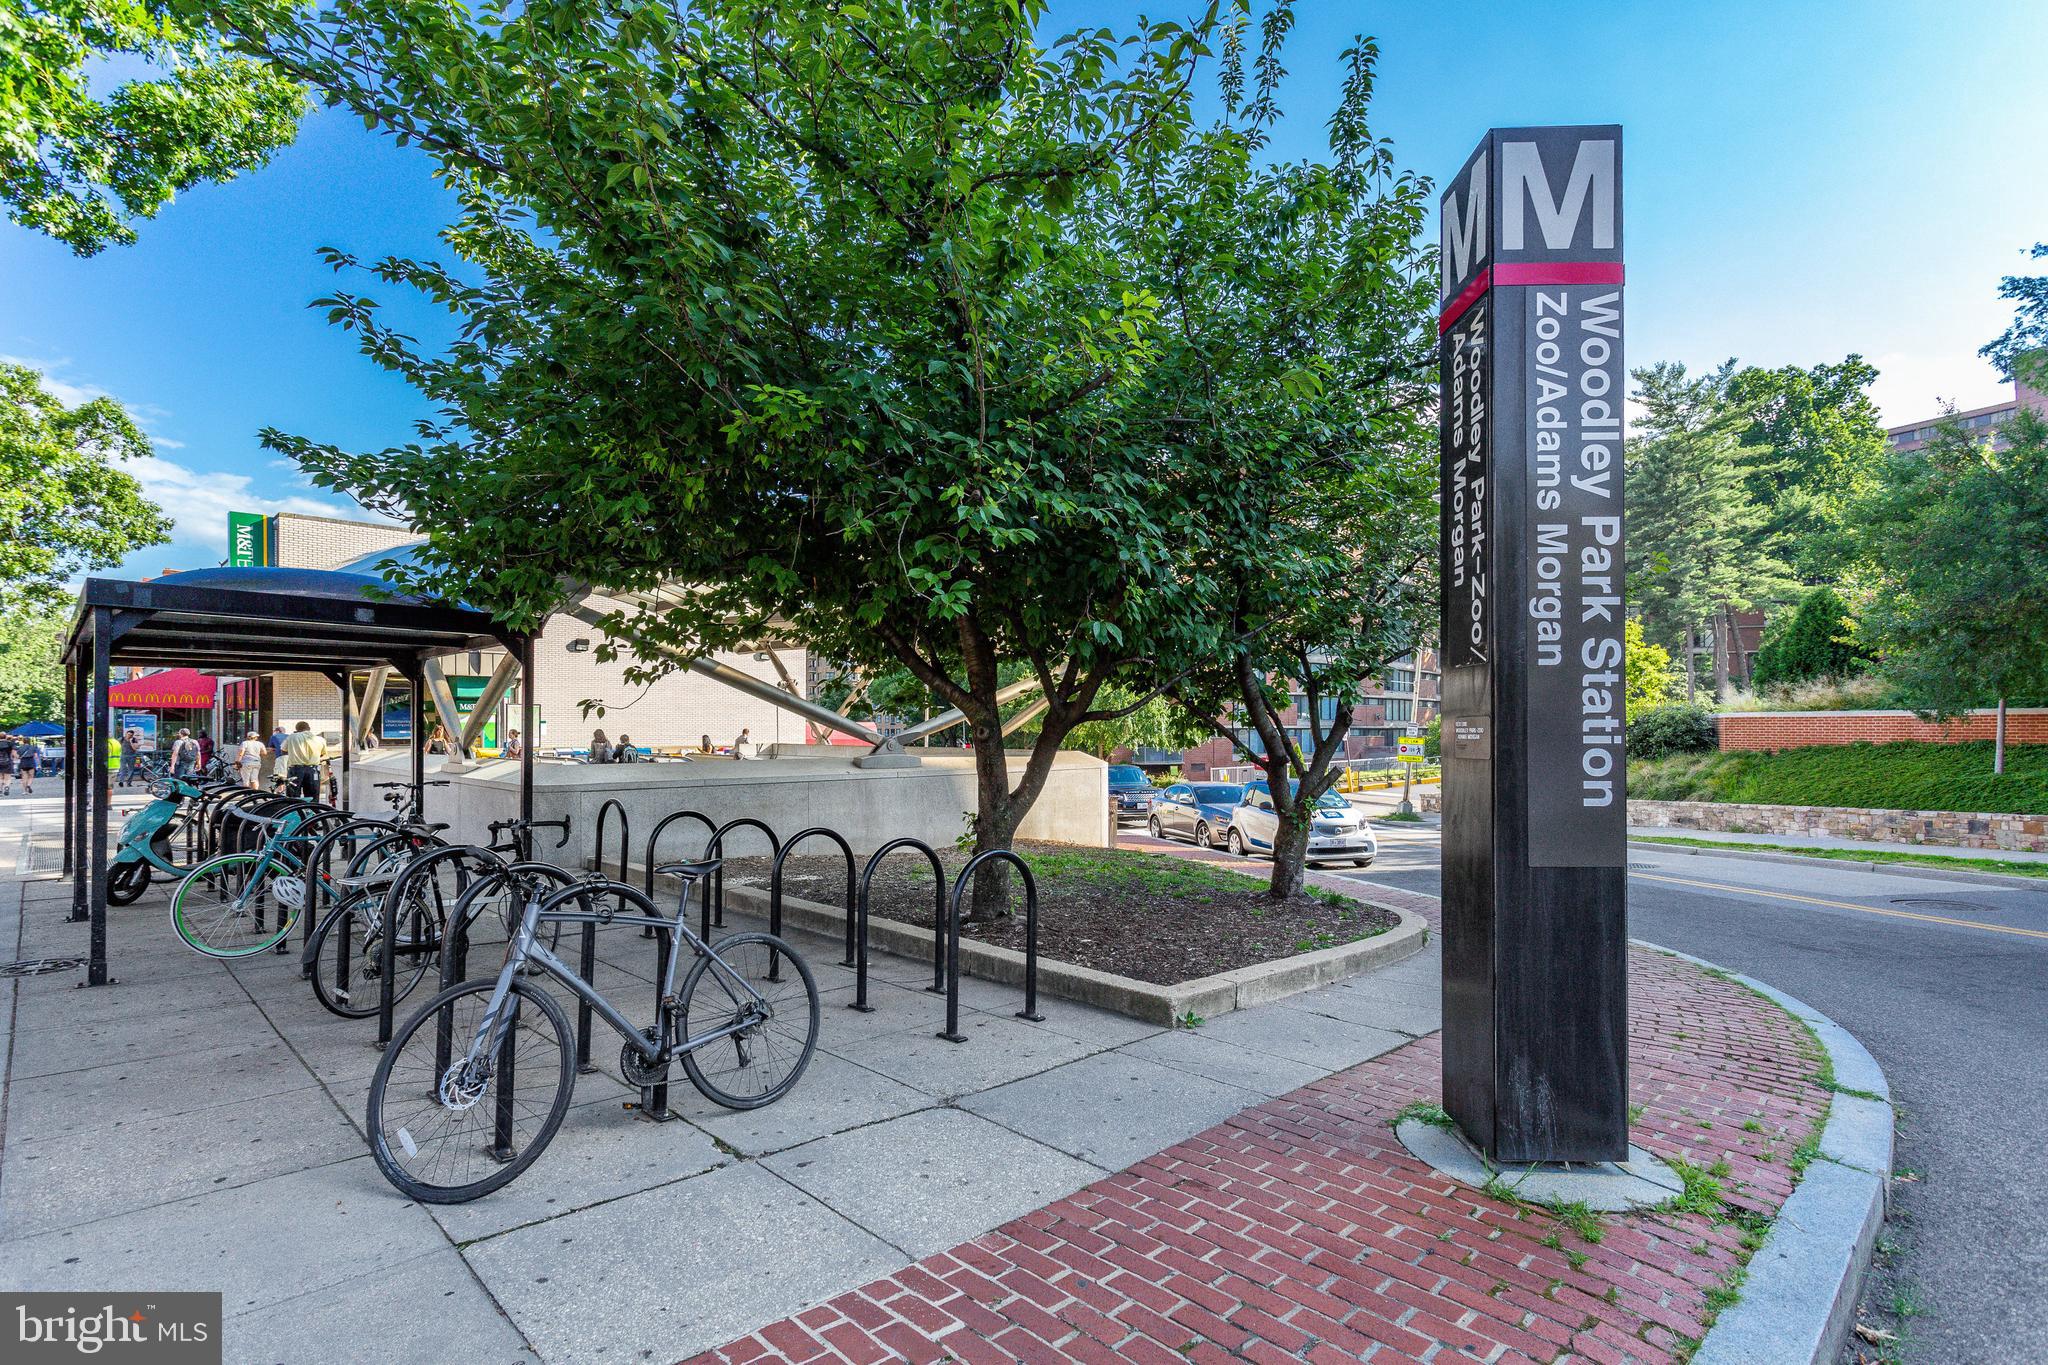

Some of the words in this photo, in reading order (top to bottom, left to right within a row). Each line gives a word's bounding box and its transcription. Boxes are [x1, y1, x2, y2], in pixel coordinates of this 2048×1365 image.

[1442, 150, 1487, 303] M
[1503, 140, 1615, 250] M
[1453, 333, 1466, 448] Adams
[1469, 306, 1485, 463] Woodley
[1535, 292, 1569, 511] Zoo/Adams
[1571, 291, 1620, 499] Woodley
[236, 523, 254, 559] M&T
[1452, 457, 1467, 587] Morgan
[1469, 476, 1487, 662] Park-Zoo/
[1528, 524, 1569, 667] Morgan
[1581, 516, 1621, 625] Park
[1581, 637, 1622, 808] Station
